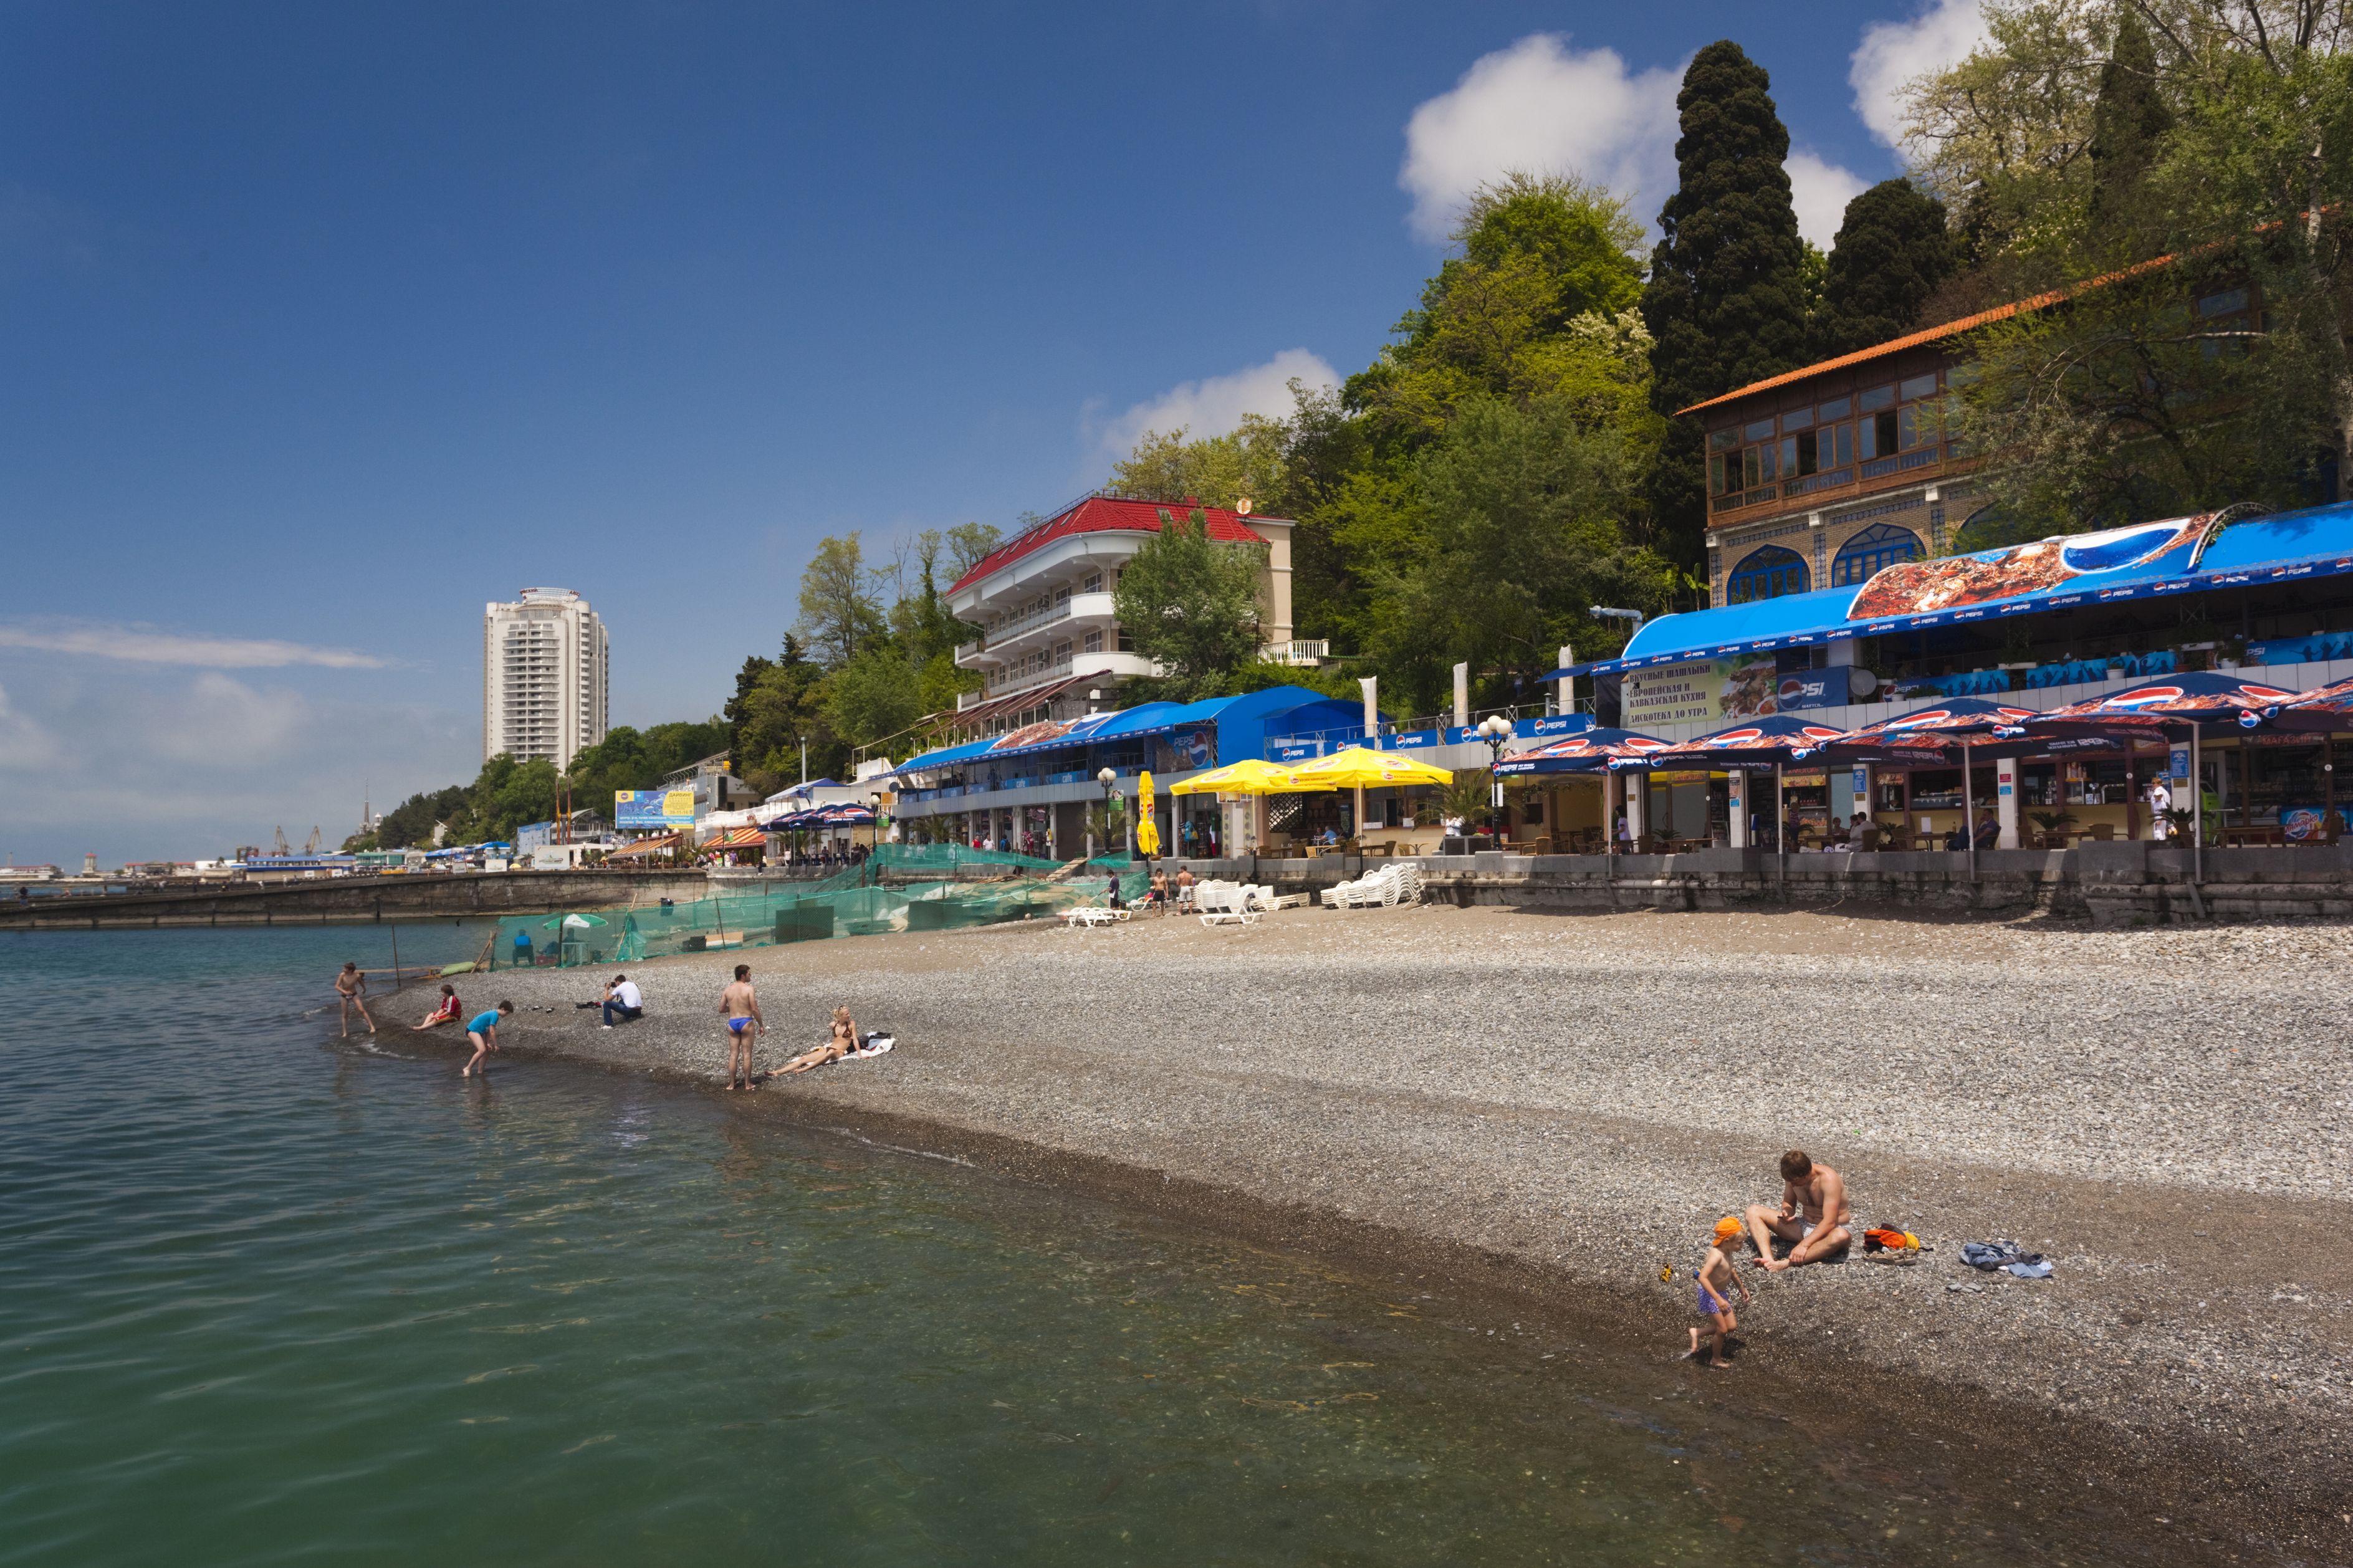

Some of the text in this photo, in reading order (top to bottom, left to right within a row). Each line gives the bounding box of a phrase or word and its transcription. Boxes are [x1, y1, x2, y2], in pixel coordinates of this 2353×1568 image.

[2288, 566, 2312, 575] PEPSI
[2113, 589, 2134, 597] PEPSI
[2246, 647, 2266, 656] PSI
[1630, 664, 1710, 682] ВКУСНЫЕ ШАШЛЫКИ
[1630, 683, 1690, 697] ЕВРОПЕЙСКАЯ И
[1801, 682, 1824, 696] PSI
[1630, 691, 1706, 708] КАВКАЗСКАЯ КУХНЯ
[1630, 707, 1707, 724] ДИСКОТЕКА ДО УТРА
[1546, 721, 1567, 729] PEPSI
[1174, 735, 1196, 747] PEPSI
[1406, 737, 1422, 745] PEPSI
[1500, 764, 1518, 772] PEPSI
